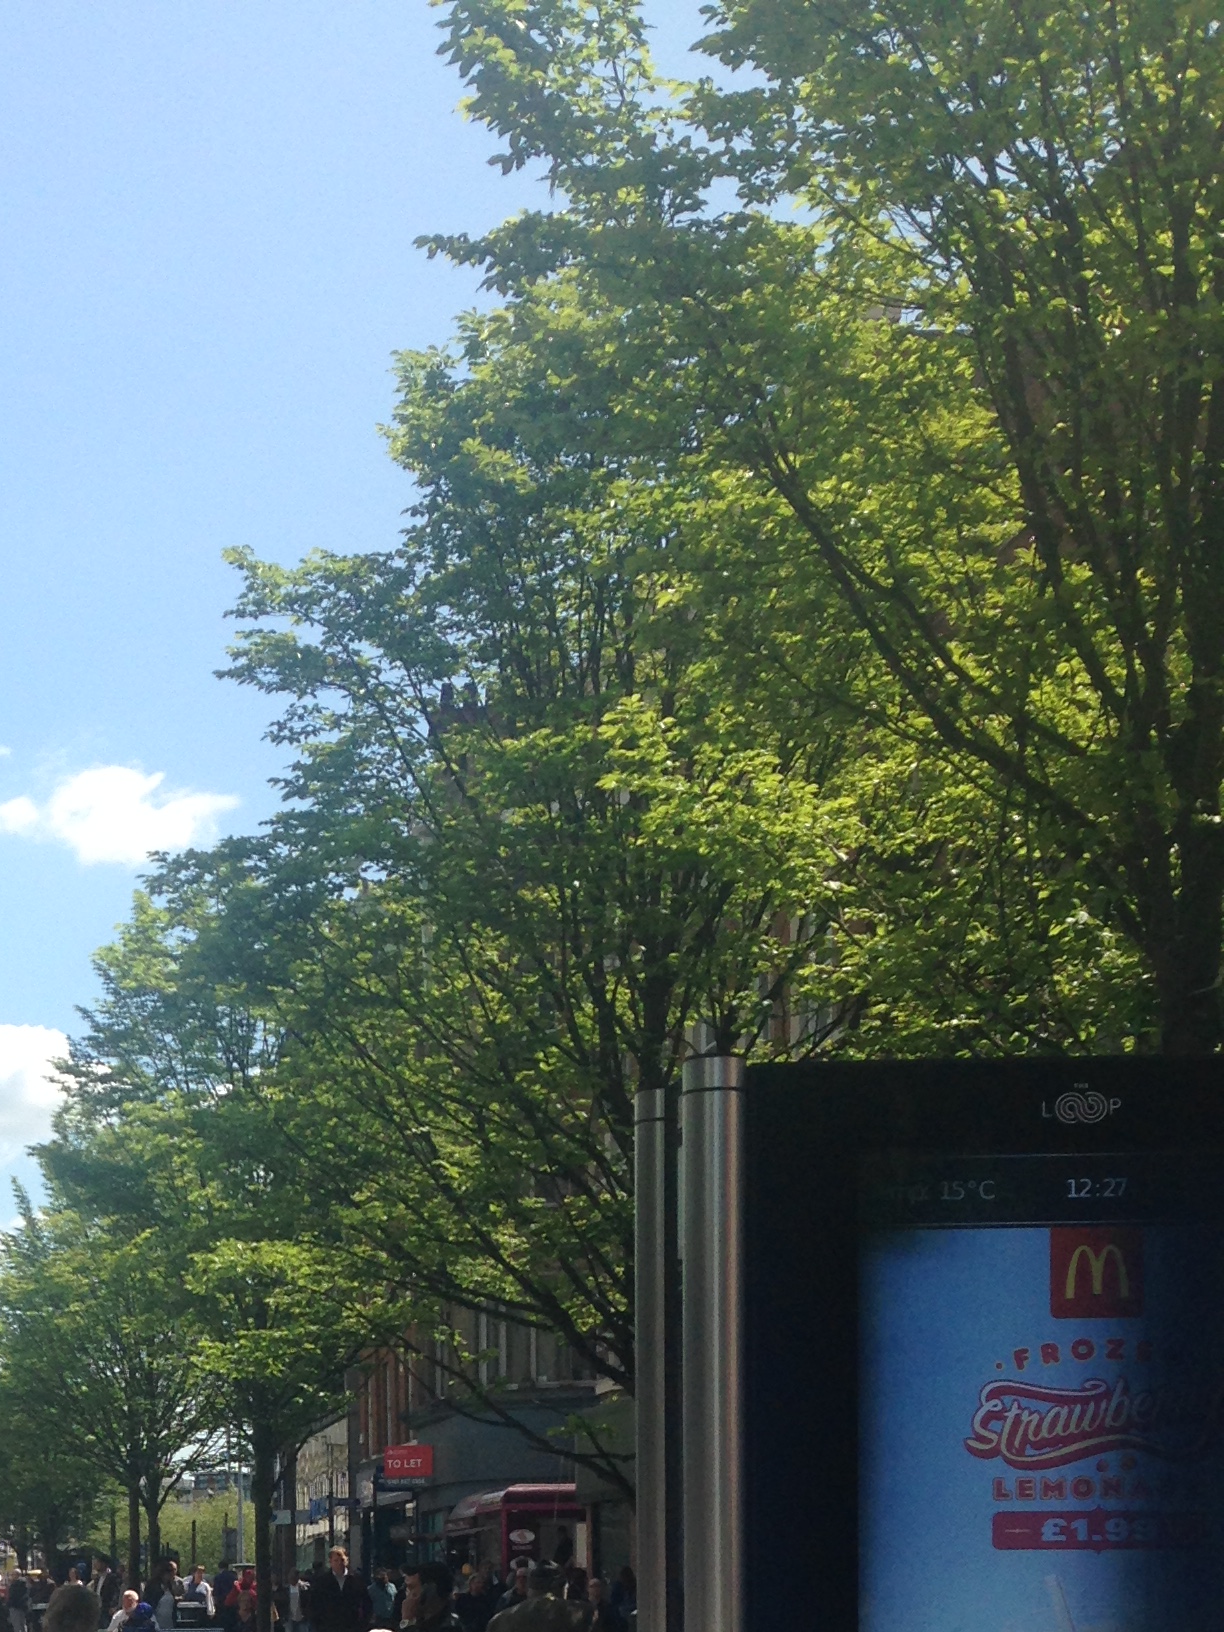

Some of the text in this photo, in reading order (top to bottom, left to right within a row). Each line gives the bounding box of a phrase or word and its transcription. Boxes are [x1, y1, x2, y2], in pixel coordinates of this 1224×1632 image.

[1066, 1177, 1128, 1199] 12:27
[1013, 1338, 1154, 1370] FROZE
[387, 1458, 423, 1469] TO LET
[992, 1476, 1152, 1501] LEMONA
